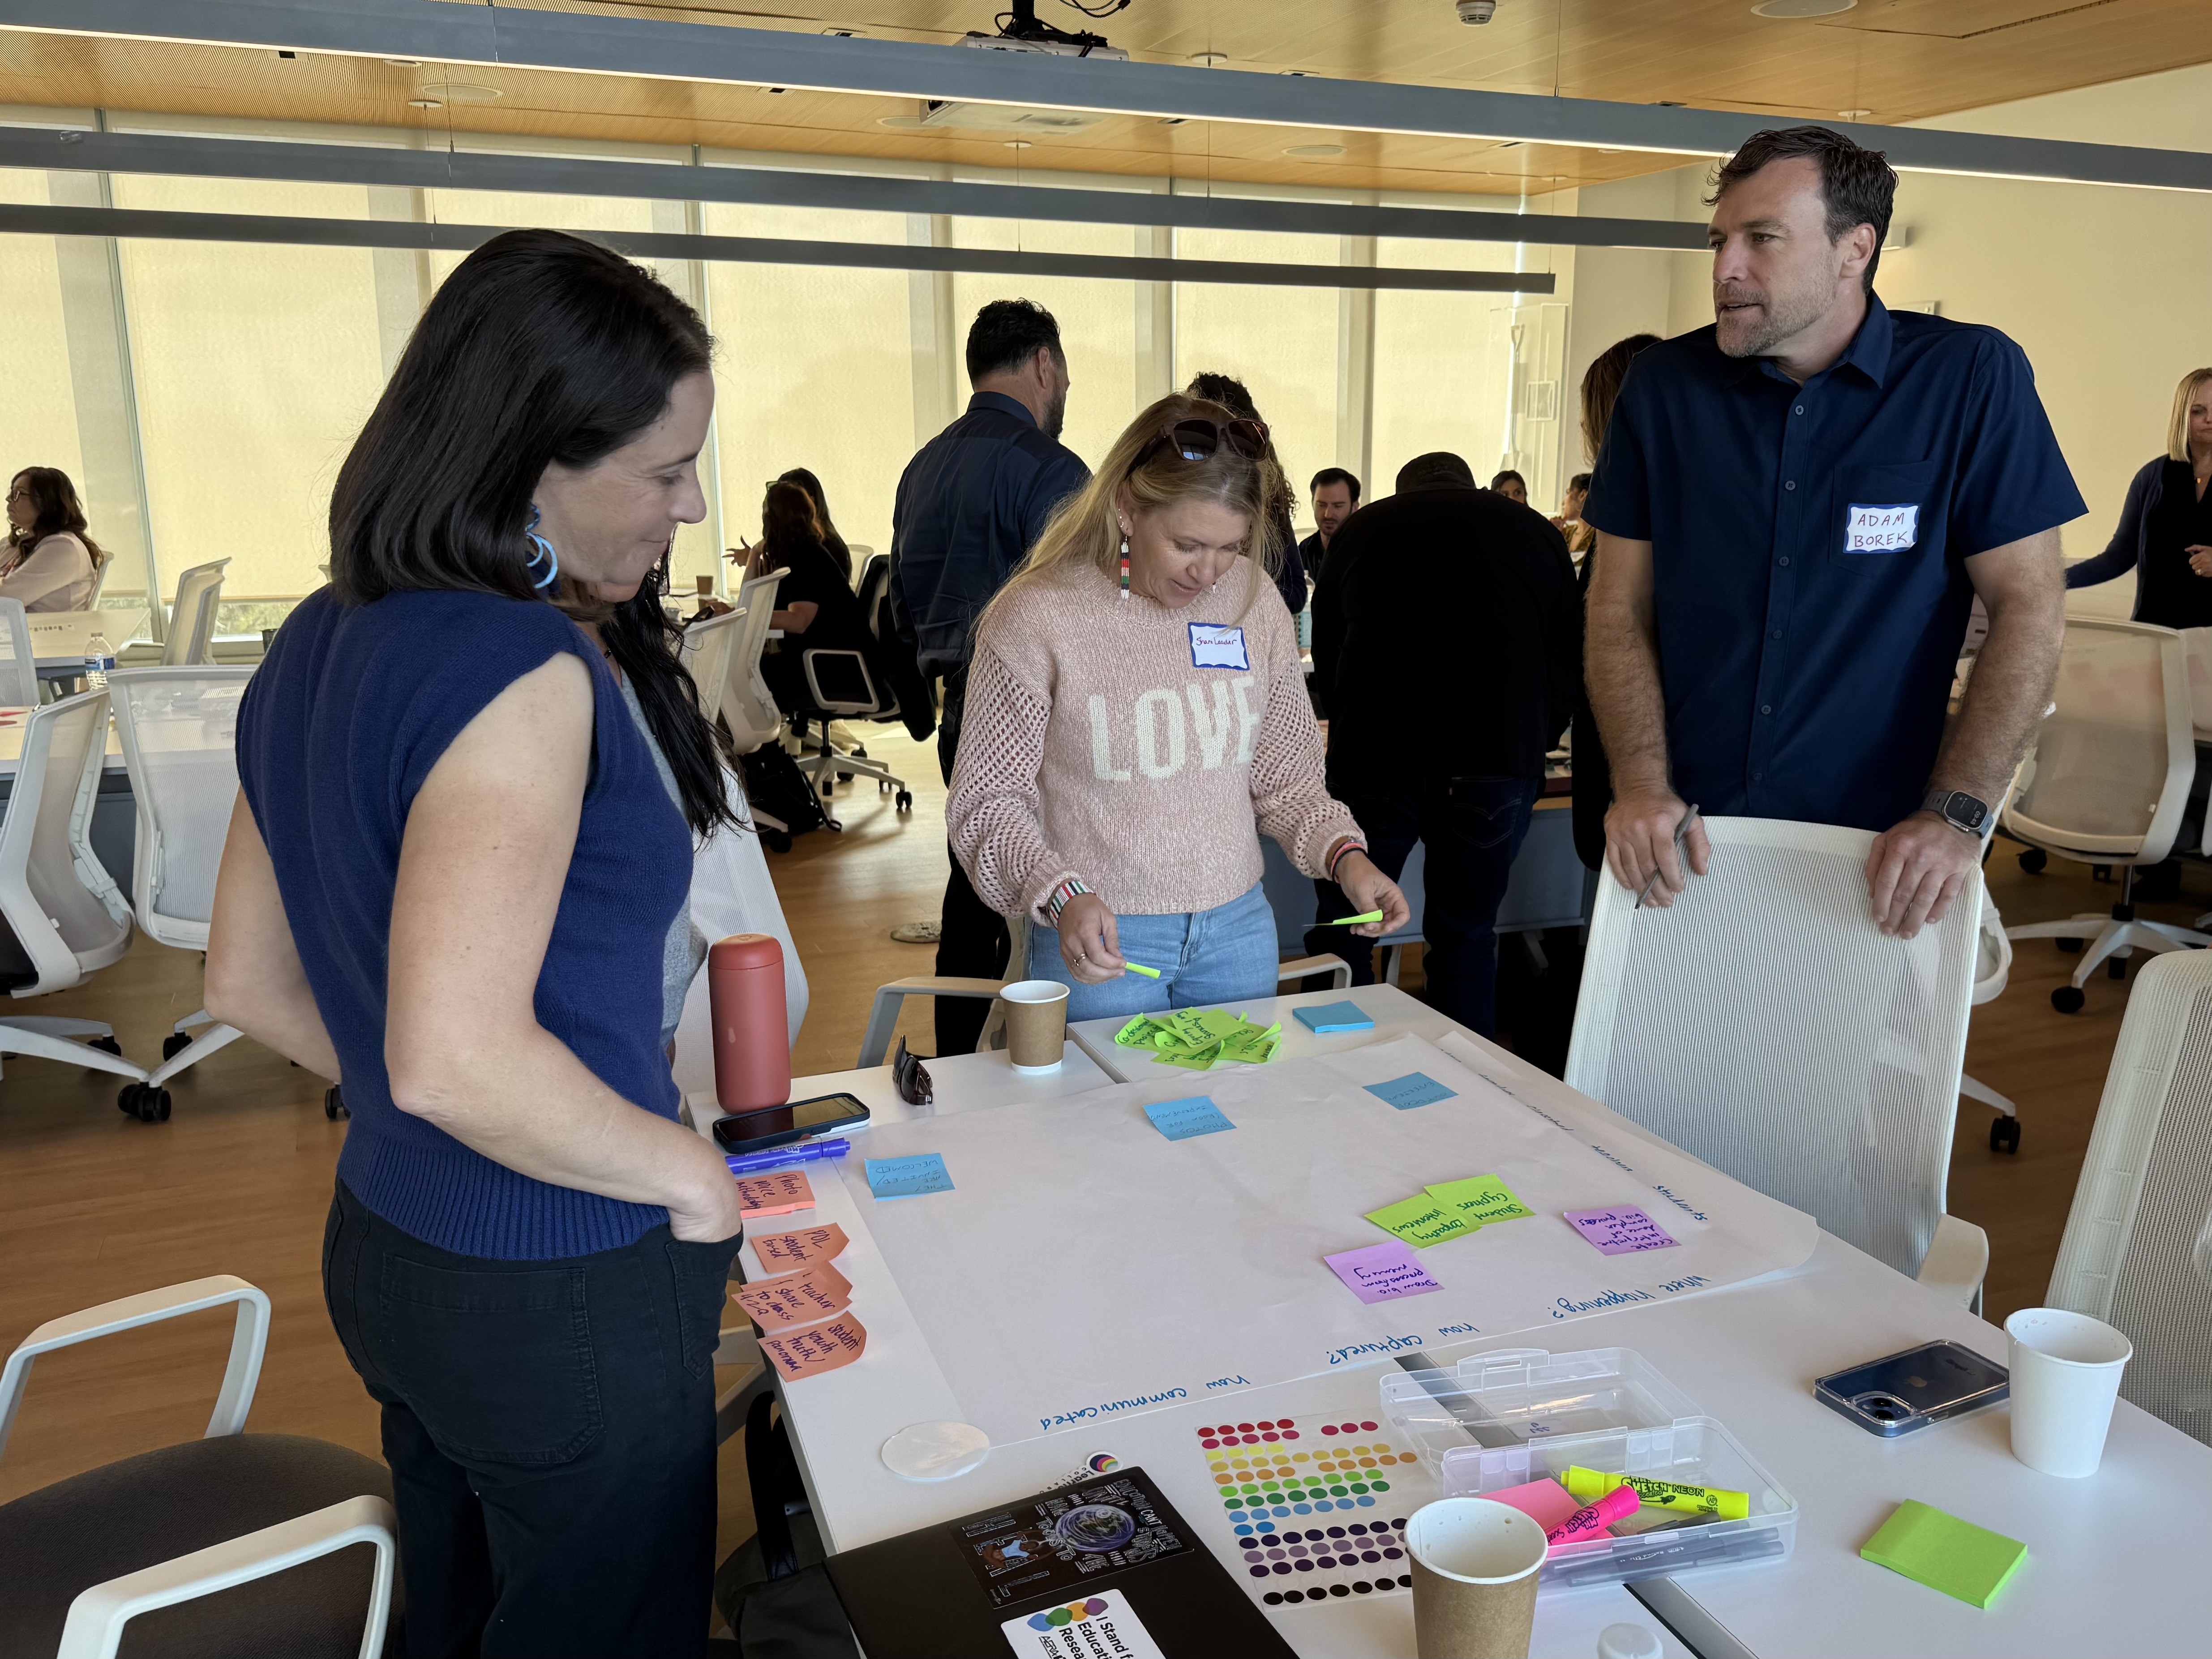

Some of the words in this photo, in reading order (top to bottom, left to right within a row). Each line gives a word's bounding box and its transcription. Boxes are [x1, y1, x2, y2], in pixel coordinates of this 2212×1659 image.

[1858, 513, 1904, 526] ADAM
[1854, 531, 1908, 547] BOREK
[1089, 675, 1260, 781] LOVE
[1180, 1122, 1228, 1135] PHOTOS
[875, 1159, 939, 1174] WELCOMED
[1458, 1192, 1509, 1211] Cyphers
[1473, 1203, 1523, 1221] Student
[1327, 1334, 1423, 1366] captured?
[1040, 1388, 1187, 1430] communicated
[1672, 1484, 1705, 1497] NEON
[1059, 1627, 1085, 1659] Resea
[1100, 1621, 1130, 1654] Stand
